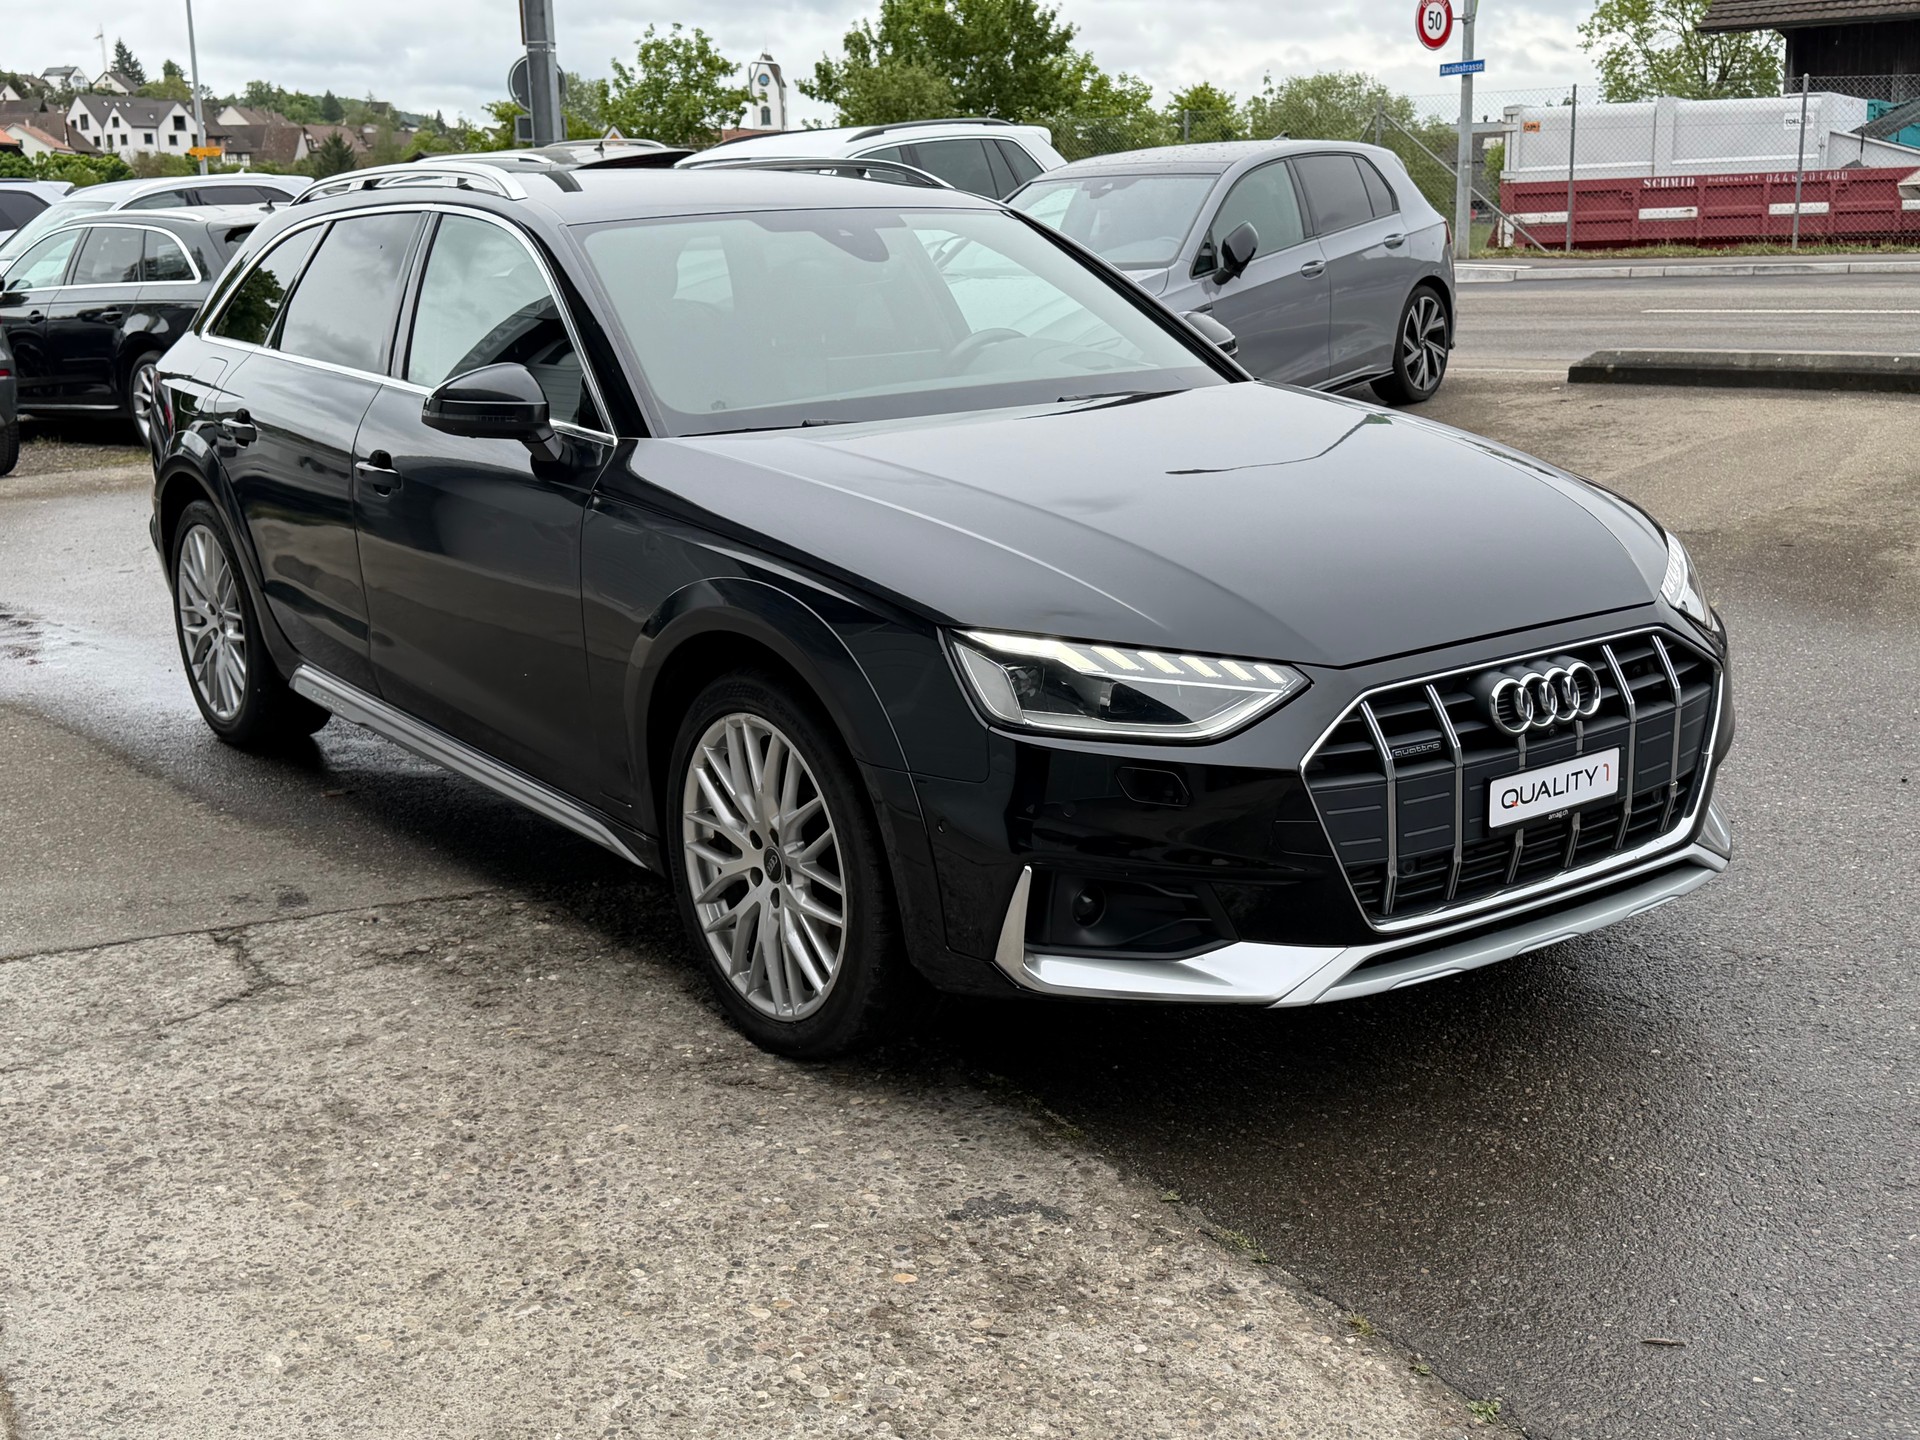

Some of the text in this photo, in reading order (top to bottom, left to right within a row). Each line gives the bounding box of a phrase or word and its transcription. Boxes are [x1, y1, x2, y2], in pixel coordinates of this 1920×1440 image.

[1428, 11, 1442, 30] 50
[1643, 177, 1695, 188] SCHMID
[1395, 743, 1440, 757] quattro
[1501, 763, 1610, 809] QUALITY 1
